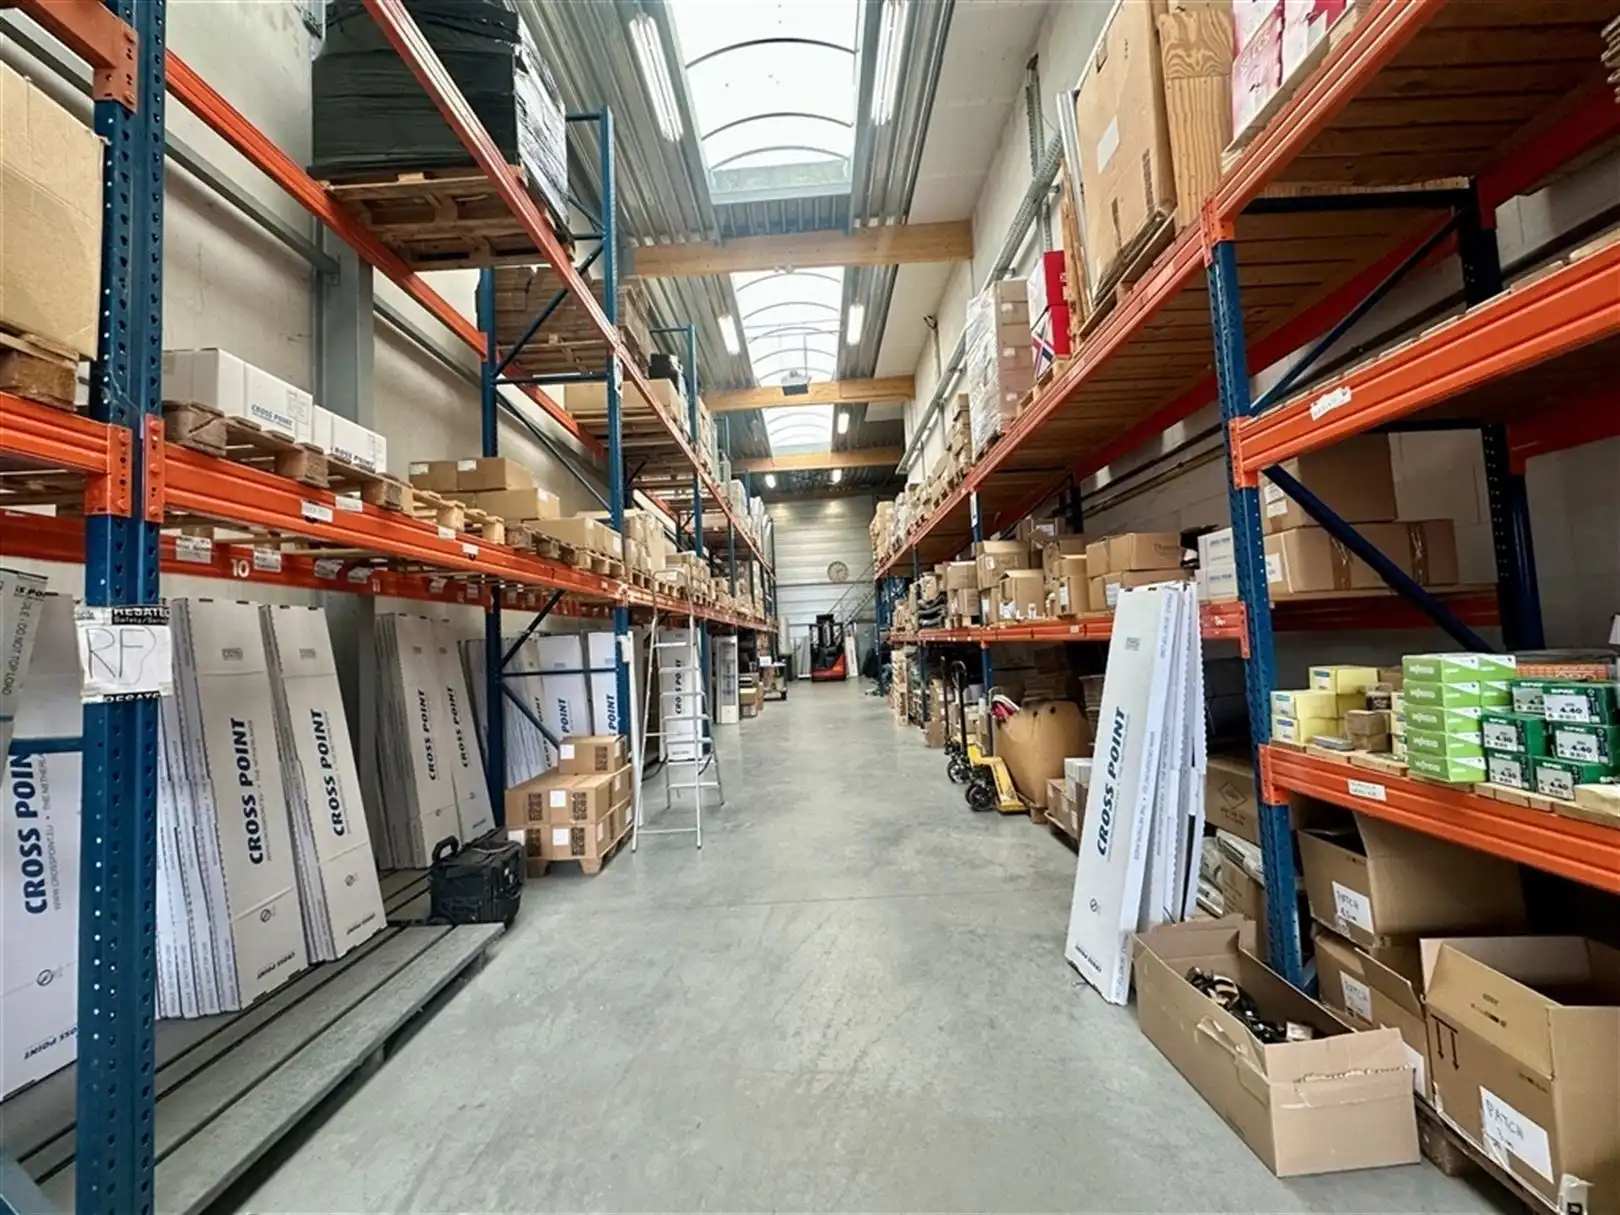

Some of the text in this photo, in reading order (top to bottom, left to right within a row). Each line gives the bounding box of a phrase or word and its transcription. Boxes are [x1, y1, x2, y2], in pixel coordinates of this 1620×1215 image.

[230, 558, 251, 578] 10
[416, 688, 437, 781] CROSS POINT
[446, 686, 469, 768] CROSS POINT
[557, 697, 571, 734] POINT
[606, 693, 618, 731] POINT
[230, 717, 264, 865] CROSS POINT
[310, 708, 345, 837] CROSS POINT
[1096, 783, 1117, 857] CROSS
[1107, 705, 1127, 779] POINT
[9, 750, 47, 915] CROSS POIN
